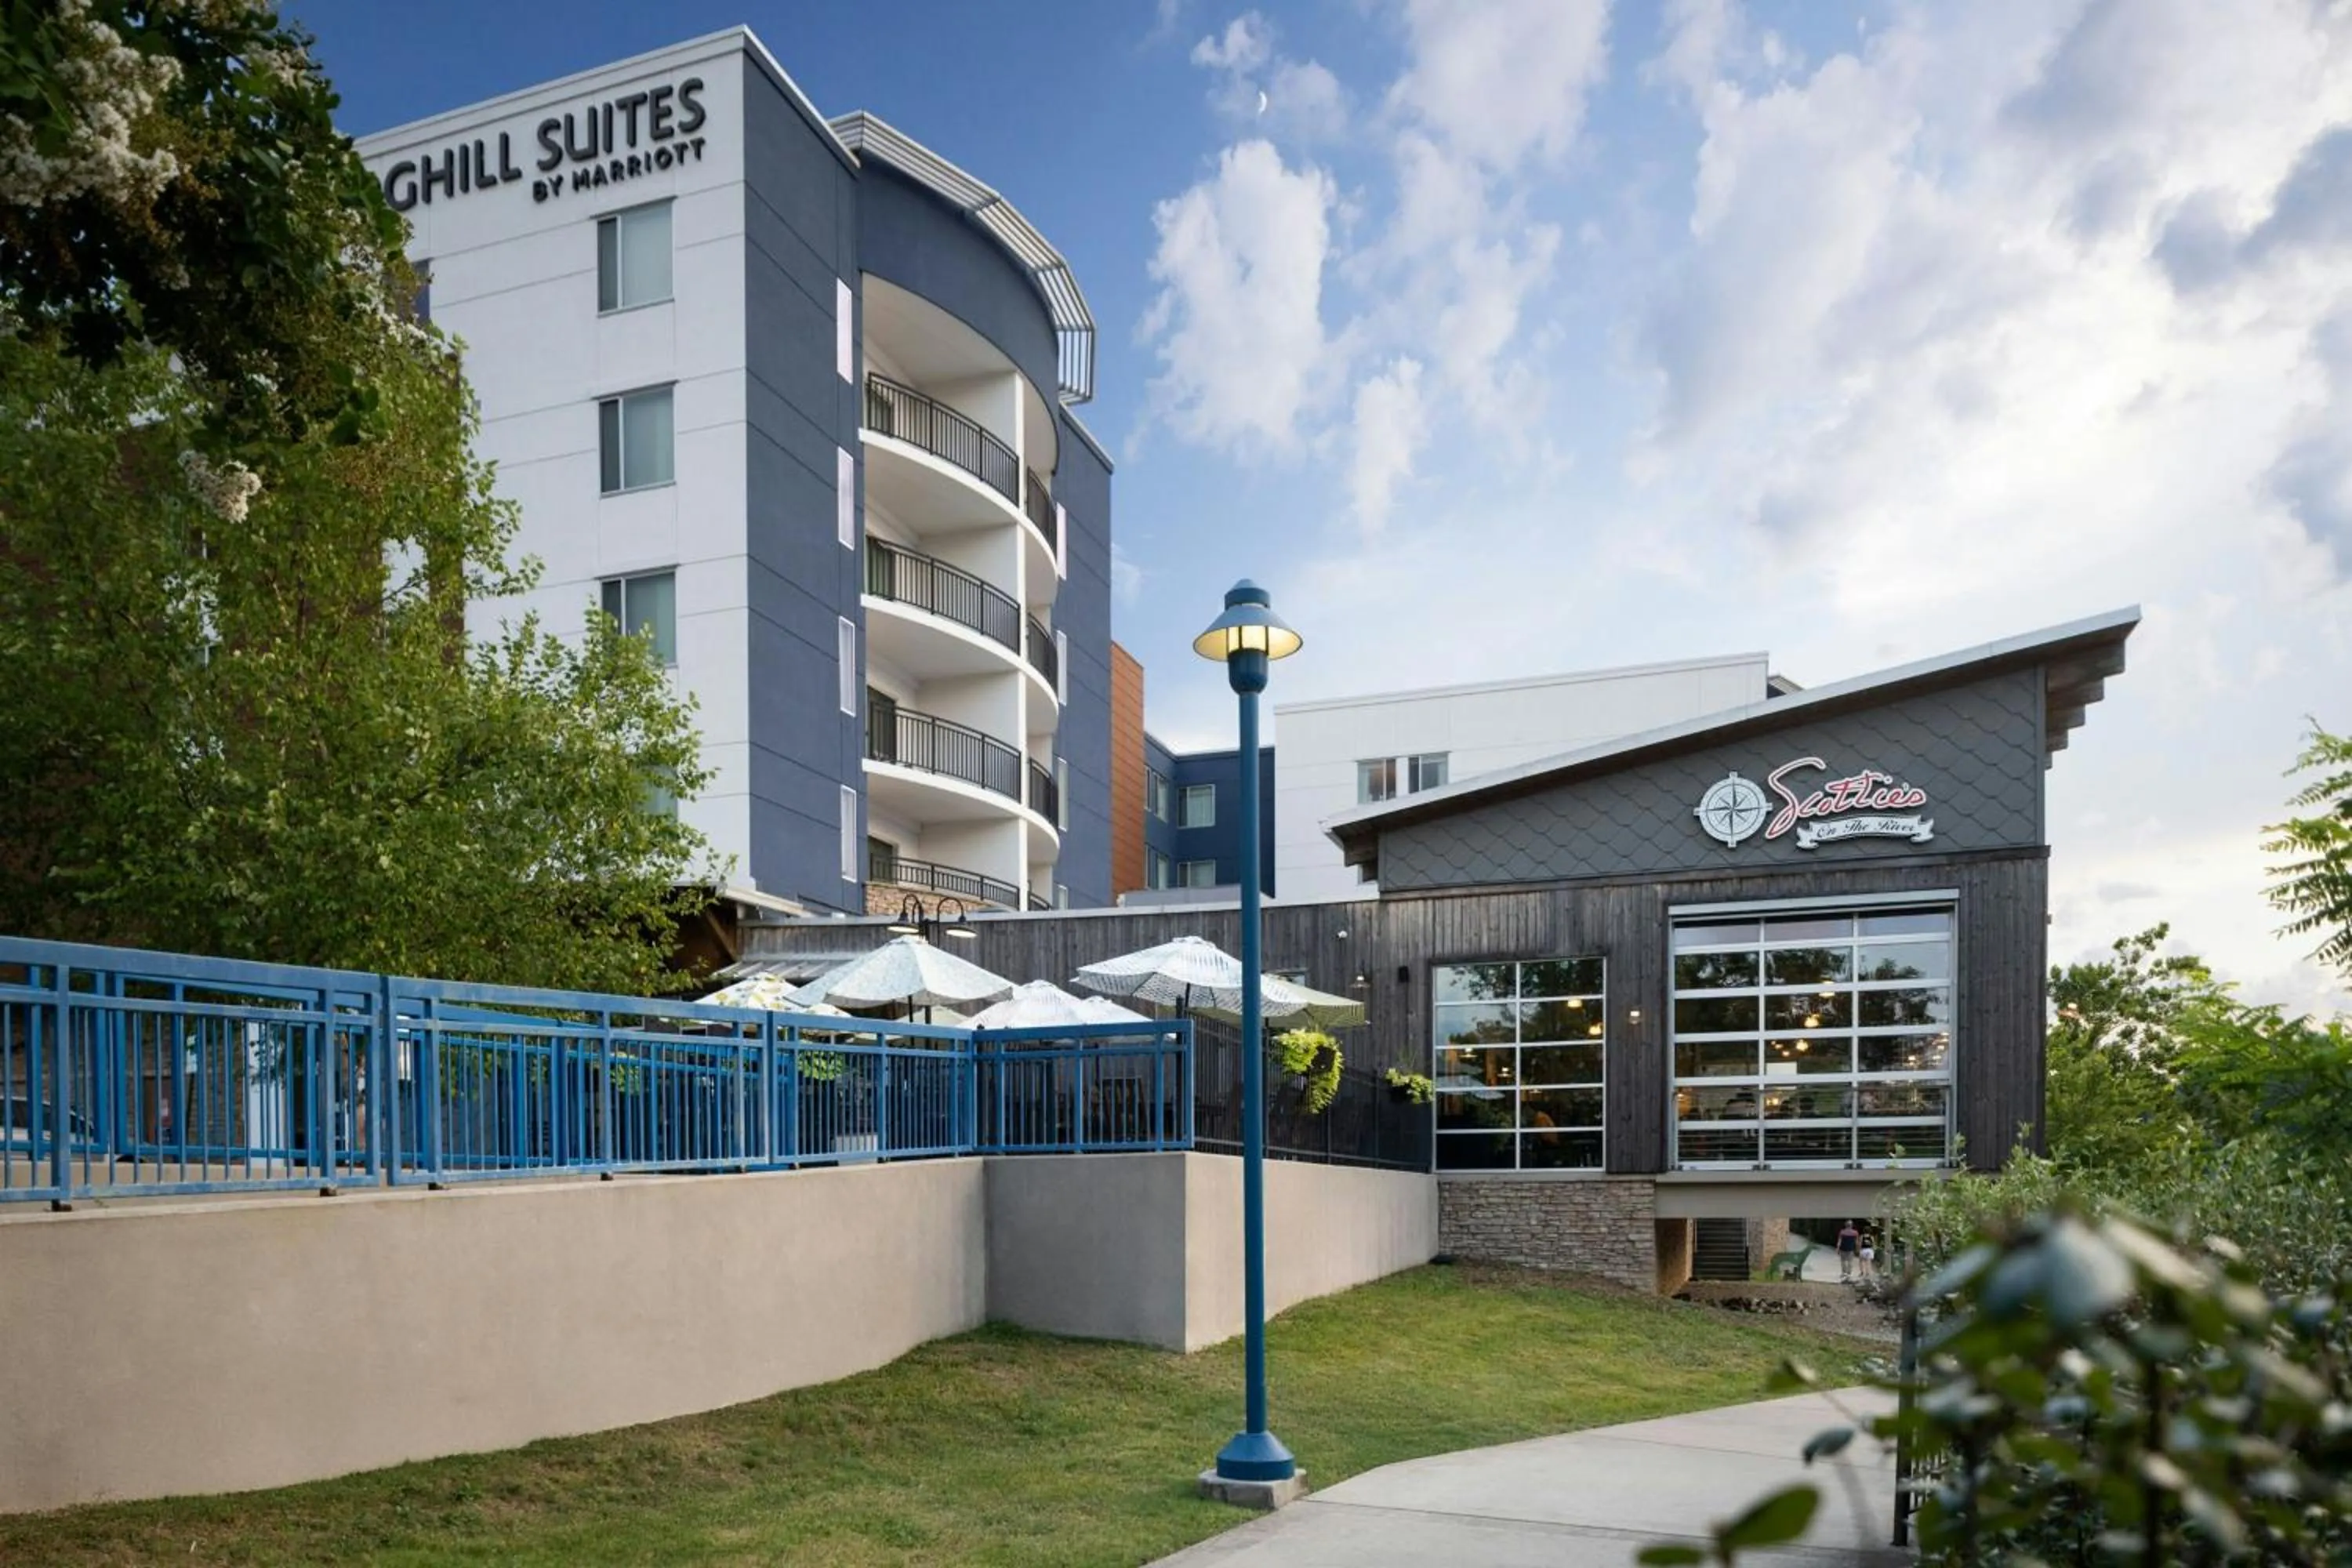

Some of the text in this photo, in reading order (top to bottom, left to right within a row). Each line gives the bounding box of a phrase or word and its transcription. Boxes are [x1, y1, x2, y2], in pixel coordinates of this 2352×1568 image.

[383, 78, 707, 212] GHILL SUITES
[532, 137, 706, 203] BY MARRIOTT
[1817, 824, 1837, 838] On
[1844, 819, 1870, 833] The
